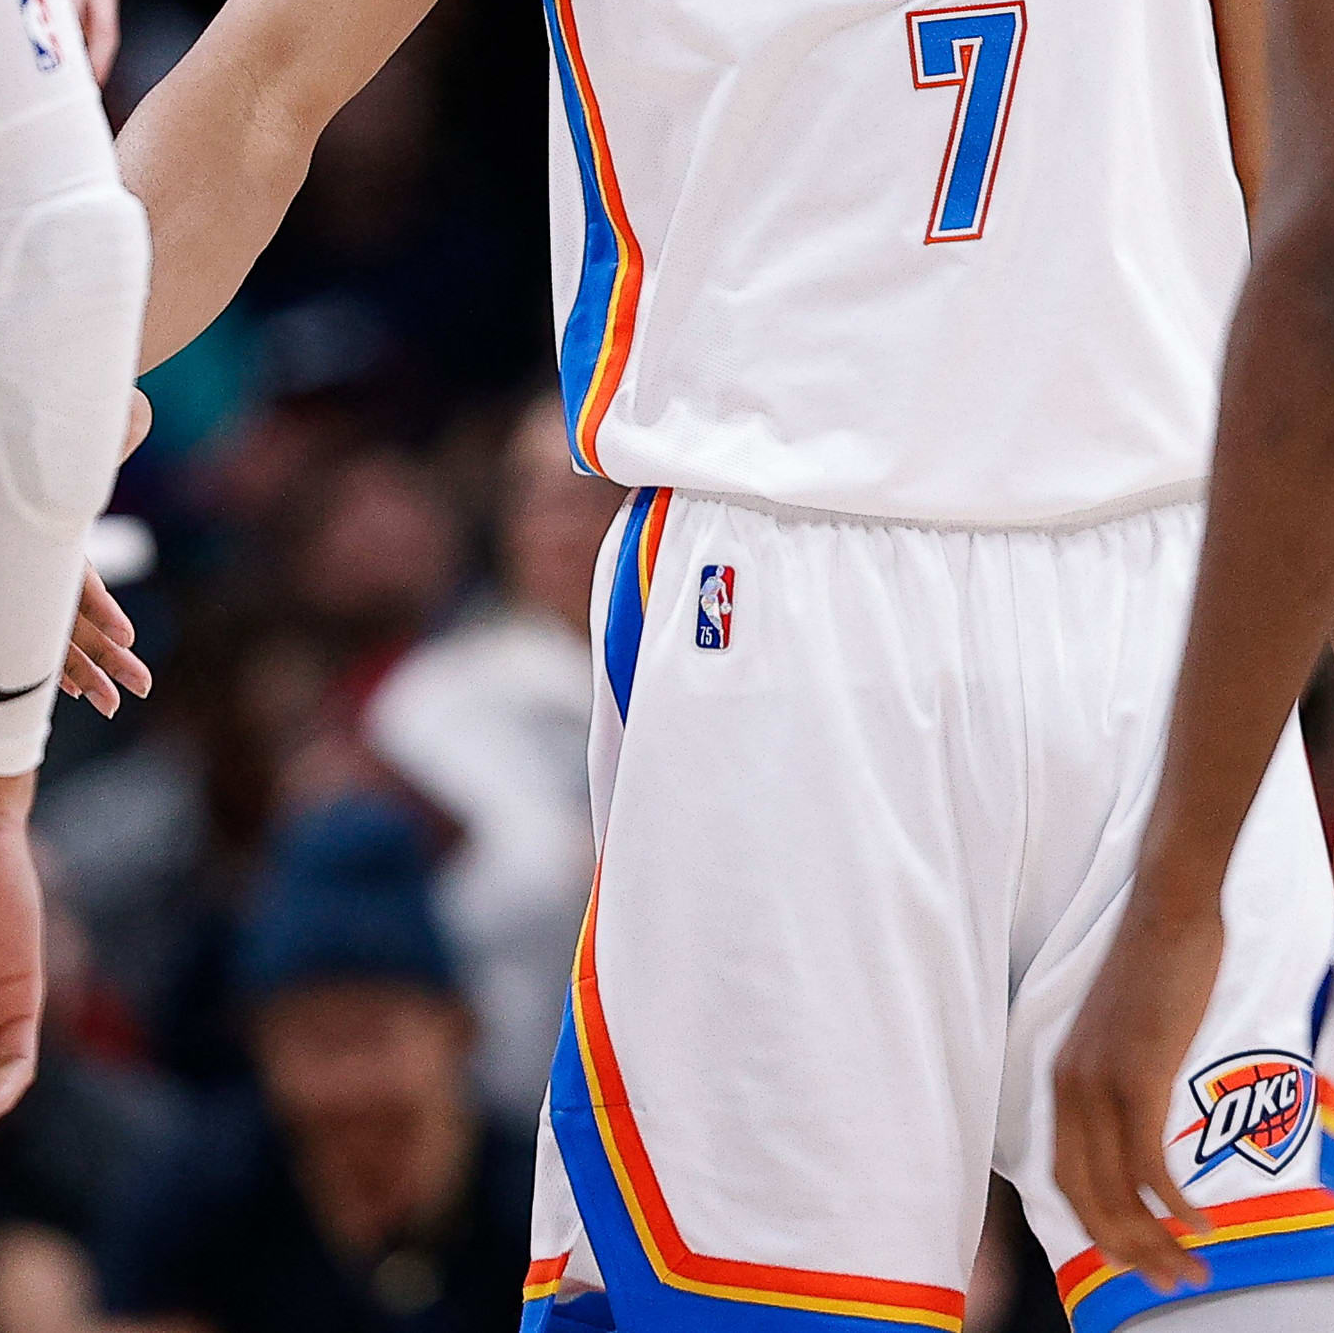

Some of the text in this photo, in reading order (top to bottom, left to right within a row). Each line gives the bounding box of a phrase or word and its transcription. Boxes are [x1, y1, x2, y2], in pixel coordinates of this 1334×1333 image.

[905, 0, 1028, 246] 7
[700, 626, 713, 645] 75
[1201, 1071, 1297, 1157] OKC
